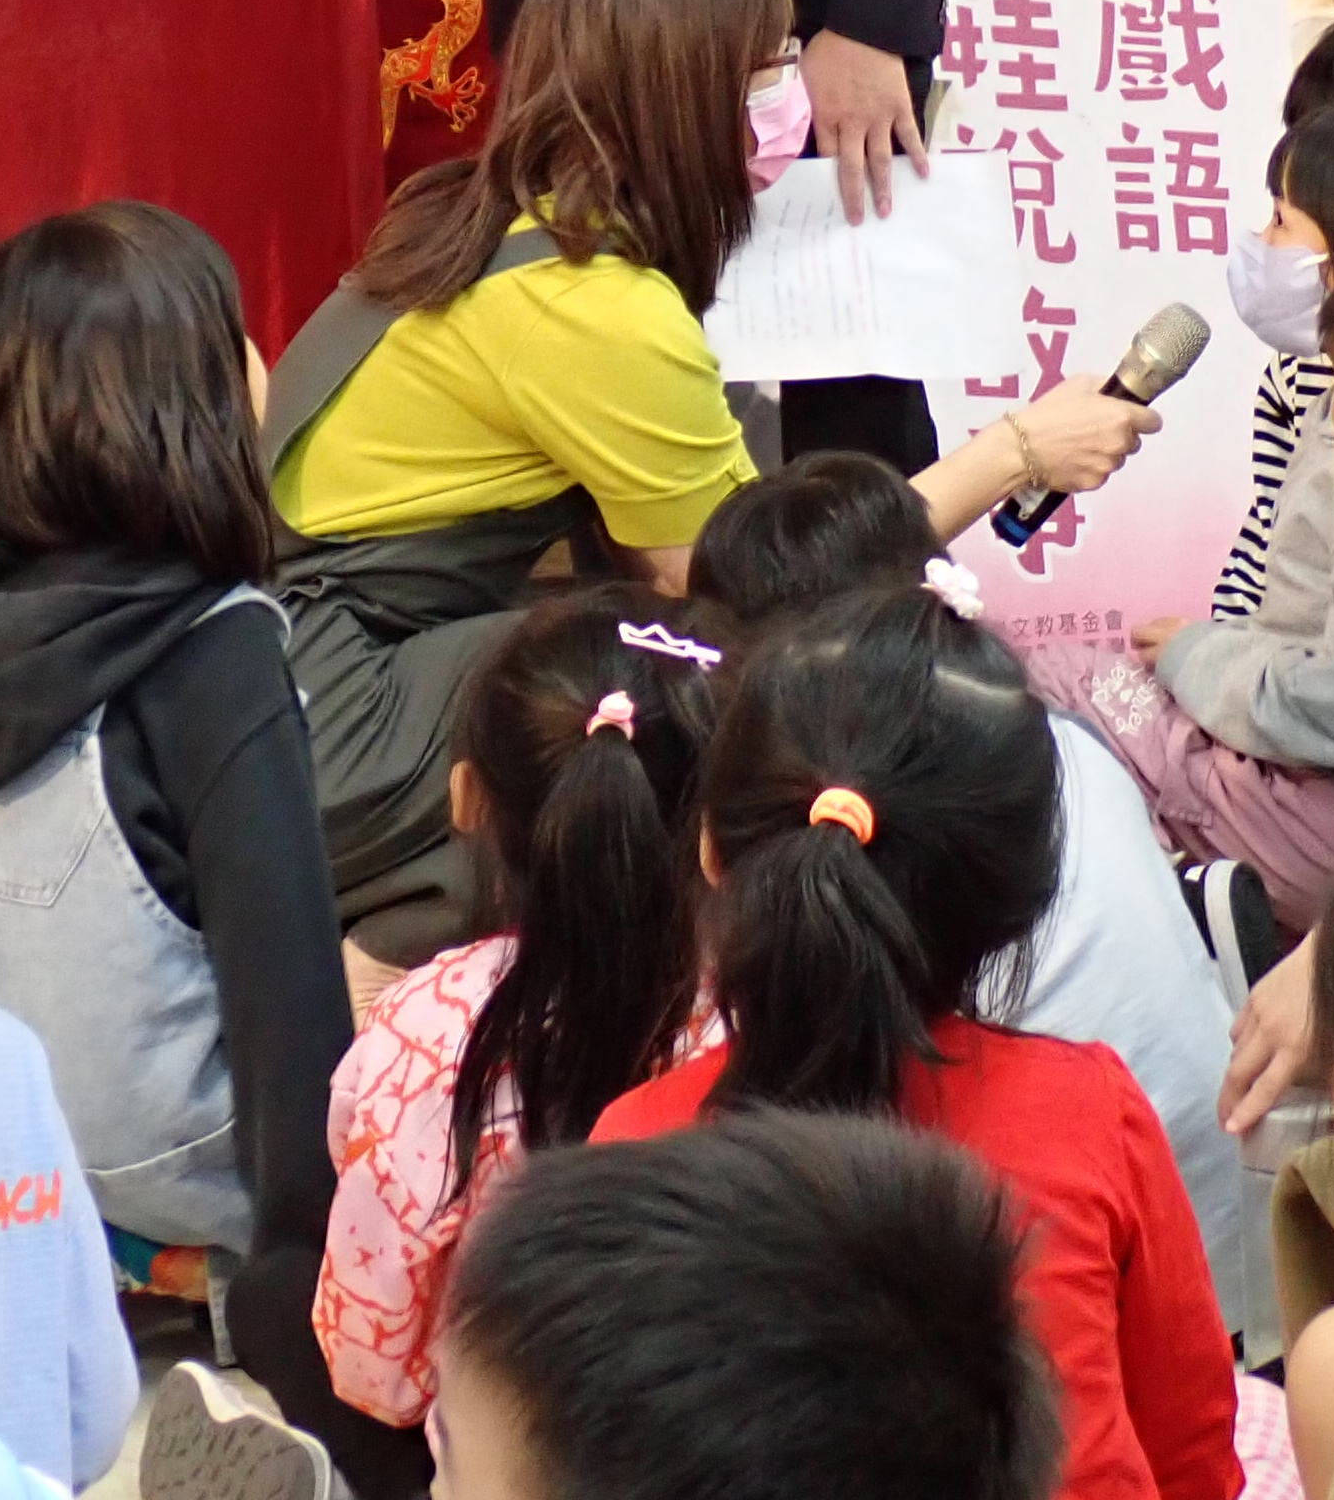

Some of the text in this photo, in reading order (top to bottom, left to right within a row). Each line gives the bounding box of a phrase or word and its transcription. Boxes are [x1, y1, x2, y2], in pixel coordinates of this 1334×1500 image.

[1001, 608, 1124, 638] 文教基金會
